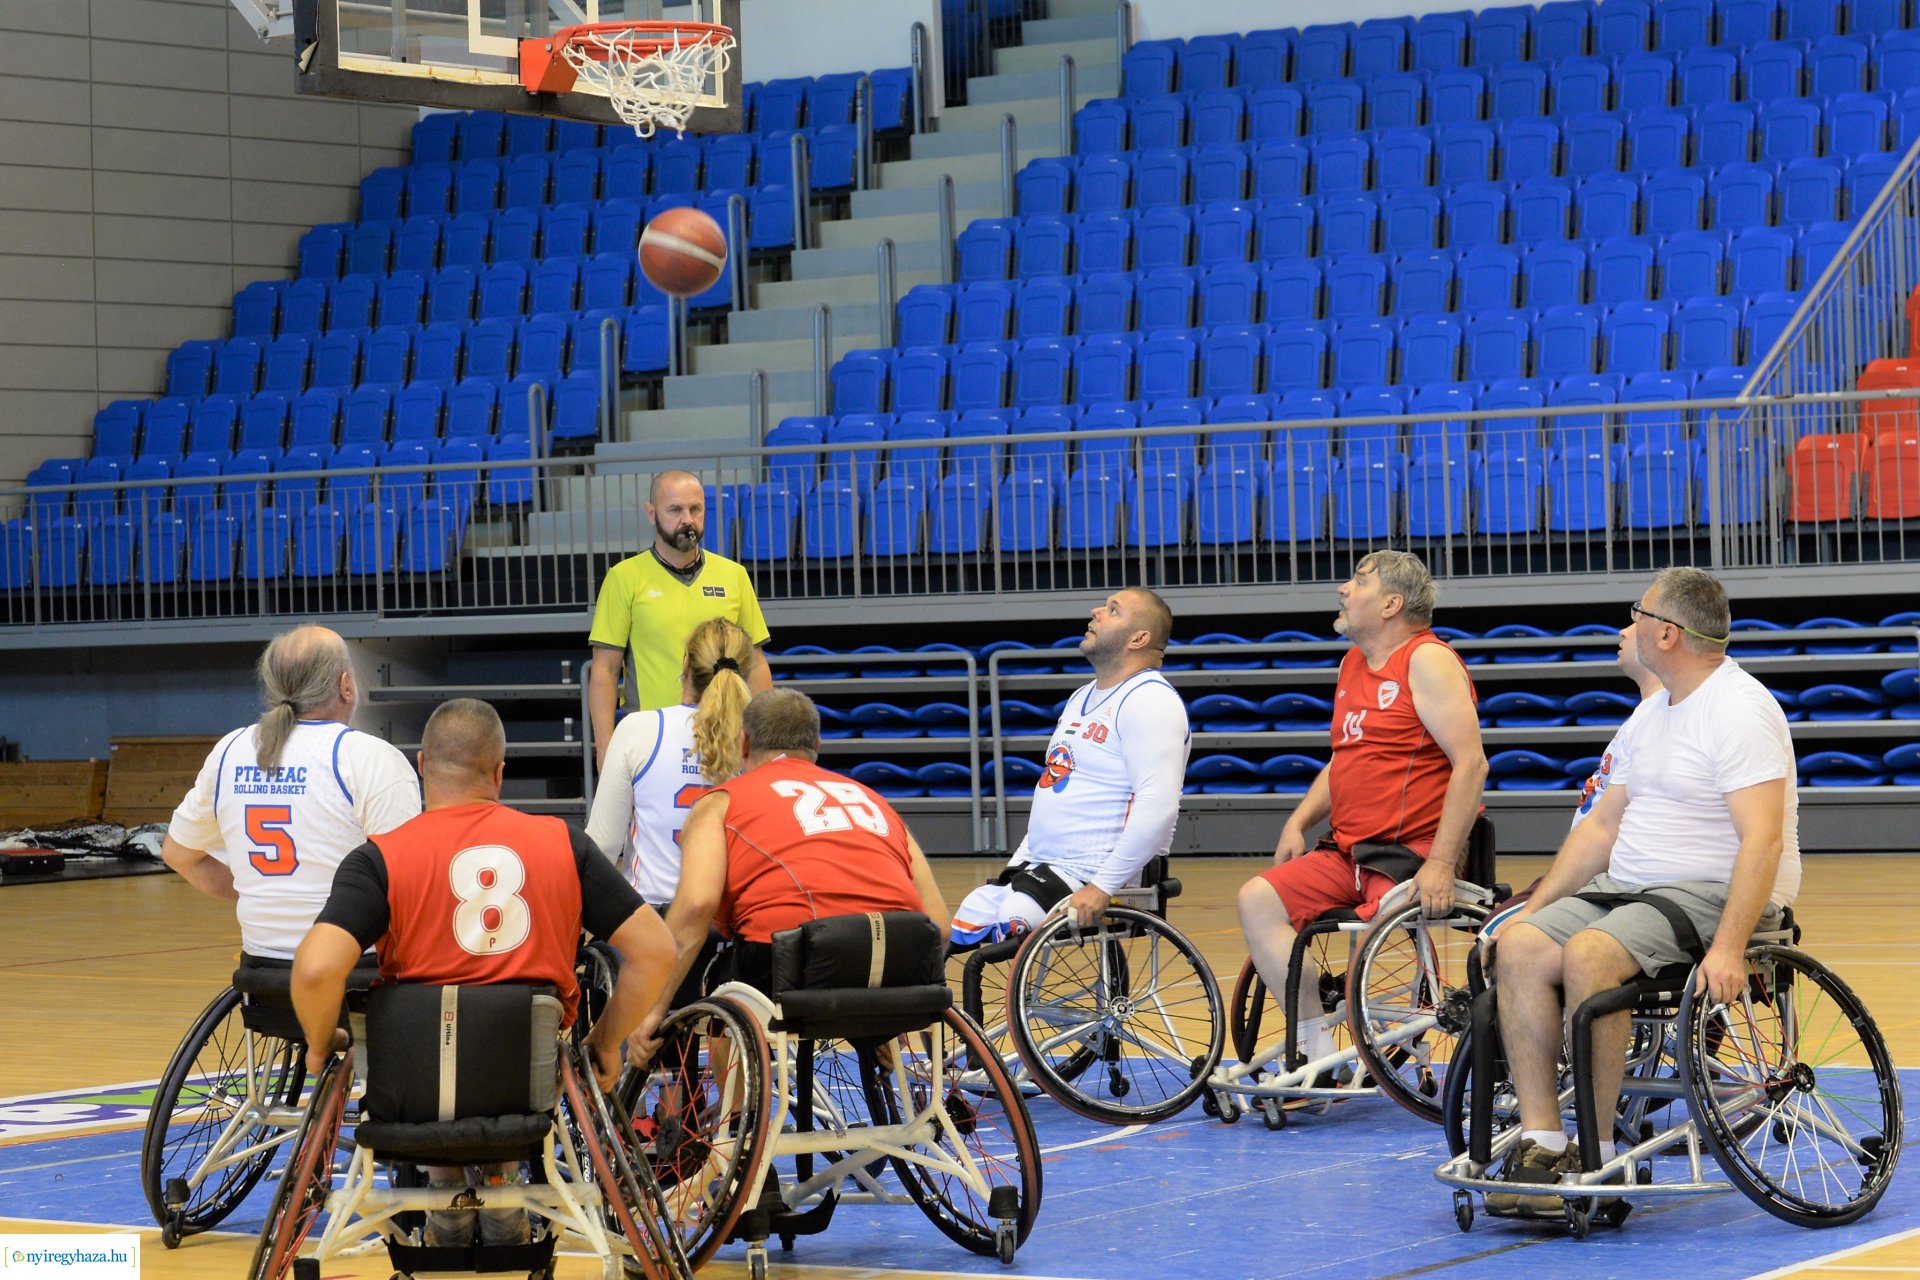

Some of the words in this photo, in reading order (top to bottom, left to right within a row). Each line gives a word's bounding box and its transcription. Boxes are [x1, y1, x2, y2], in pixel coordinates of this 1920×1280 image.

[1082, 722, 1109, 744] 30
[1339, 709, 1367, 743] 14
[234, 766, 261, 783] PTE
[266, 766, 307, 783] PEAC
[682, 765, 701, 774] ROL
[234, 784, 268, 795] ROLLING
[270, 784, 307, 795] BASKET
[769, 780, 890, 837] 25
[245, 804, 300, 876] 5
[448, 844, 531, 956] 8
